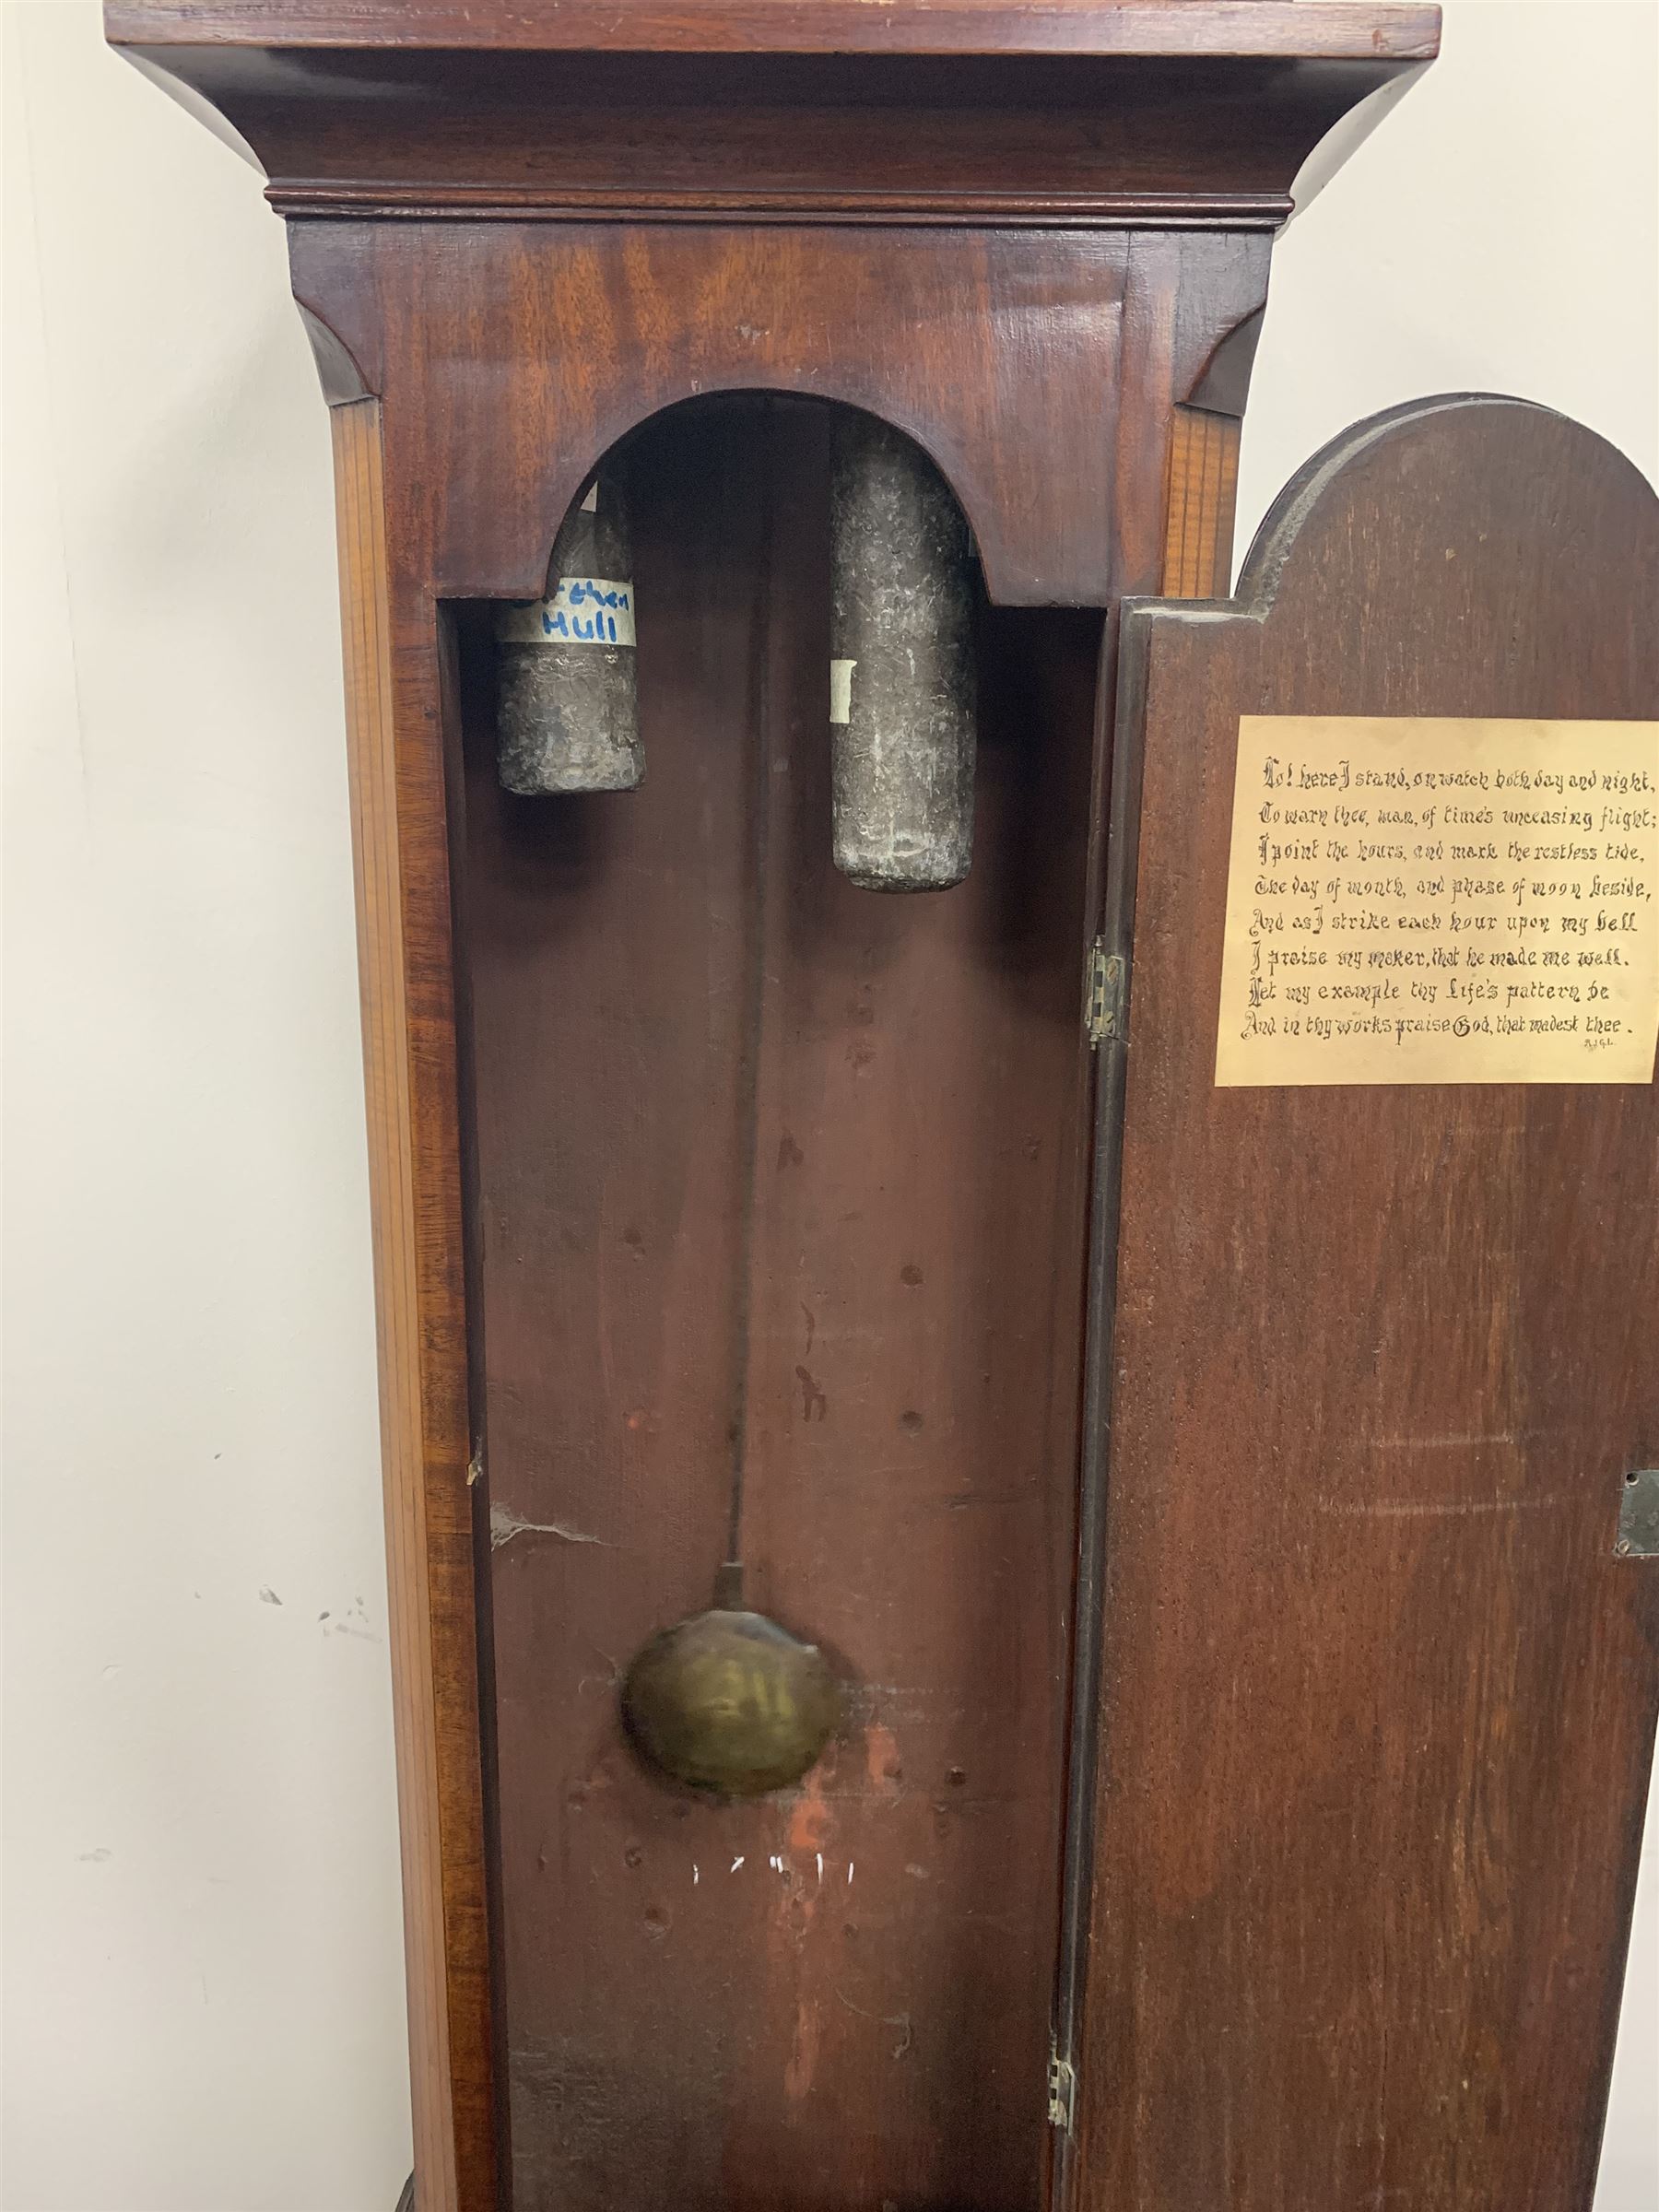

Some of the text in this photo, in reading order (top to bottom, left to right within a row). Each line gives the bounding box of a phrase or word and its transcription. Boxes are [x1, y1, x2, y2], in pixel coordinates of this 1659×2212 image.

[542, 610, 617, 642] Hull
[1263, 756, 1292, 788] Lo!
[1296, 764, 1337, 789] here
[1355, 767, 1410, 791] stand,
[1494, 769, 1530, 790] both
[1534, 770, 1564, 794] day
[1569, 770, 1597, 791] and
[1258, 801, 1280, 824] To
[1422, 806, 1437, 830] of
[1271, 839, 1319, 867] point
[1326, 840, 1349, 862] the
[1414, 841, 1443, 861] and
[1451, 843, 1498, 860] mark
[1508, 841, 1530, 862] the
[1534, 842, 1597, 860] restless
[1254, 875, 1288, 894] The
[1292, 875, 1319, 900] day
[1325, 877, 1341, 903] of
[1417, 876, 1444, 896] and
[1451, 877, 1505, 904] phase
[1512, 877, 1525, 906] of
[1532, 882, 1581, 899] moon
[1249, 909, 1284, 936] And
[1332, 910, 1390, 930] strike
[1397, 912, 1441, 930] each
[1450, 912, 1497, 932] hour
[1507, 916, 1550, 938] upon
[1561, 916, 1589, 935] my
[1595, 910, 1638, 932] bell
[1268, 946, 1328, 976] praise
[1337, 950, 1363, 969] my
[1431, 947, 1460, 968] that
[1466, 947, 1485, 967] he
[1489, 947, 1537, 967] made
[1543, 949, 1570, 967] me
[1248, 977, 1277, 1007] Let
[1285, 985, 1311, 1005] my
[1318, 979, 1401, 1008] example
[1411, 982, 1438, 1003] thy
[1506, 982, 1581, 1007] pattern
[1586, 981, 1609, 1002] be
[1241, 1010, 1277, 1041] And
[1283, 1017, 1300, 1035] in
[1306, 1017, 1332, 1040] thy
[1335, 1016, 1392, 1035] works
[1395, 1014, 1451, 1045] praise
[1497, 1015, 1525, 1035] that
